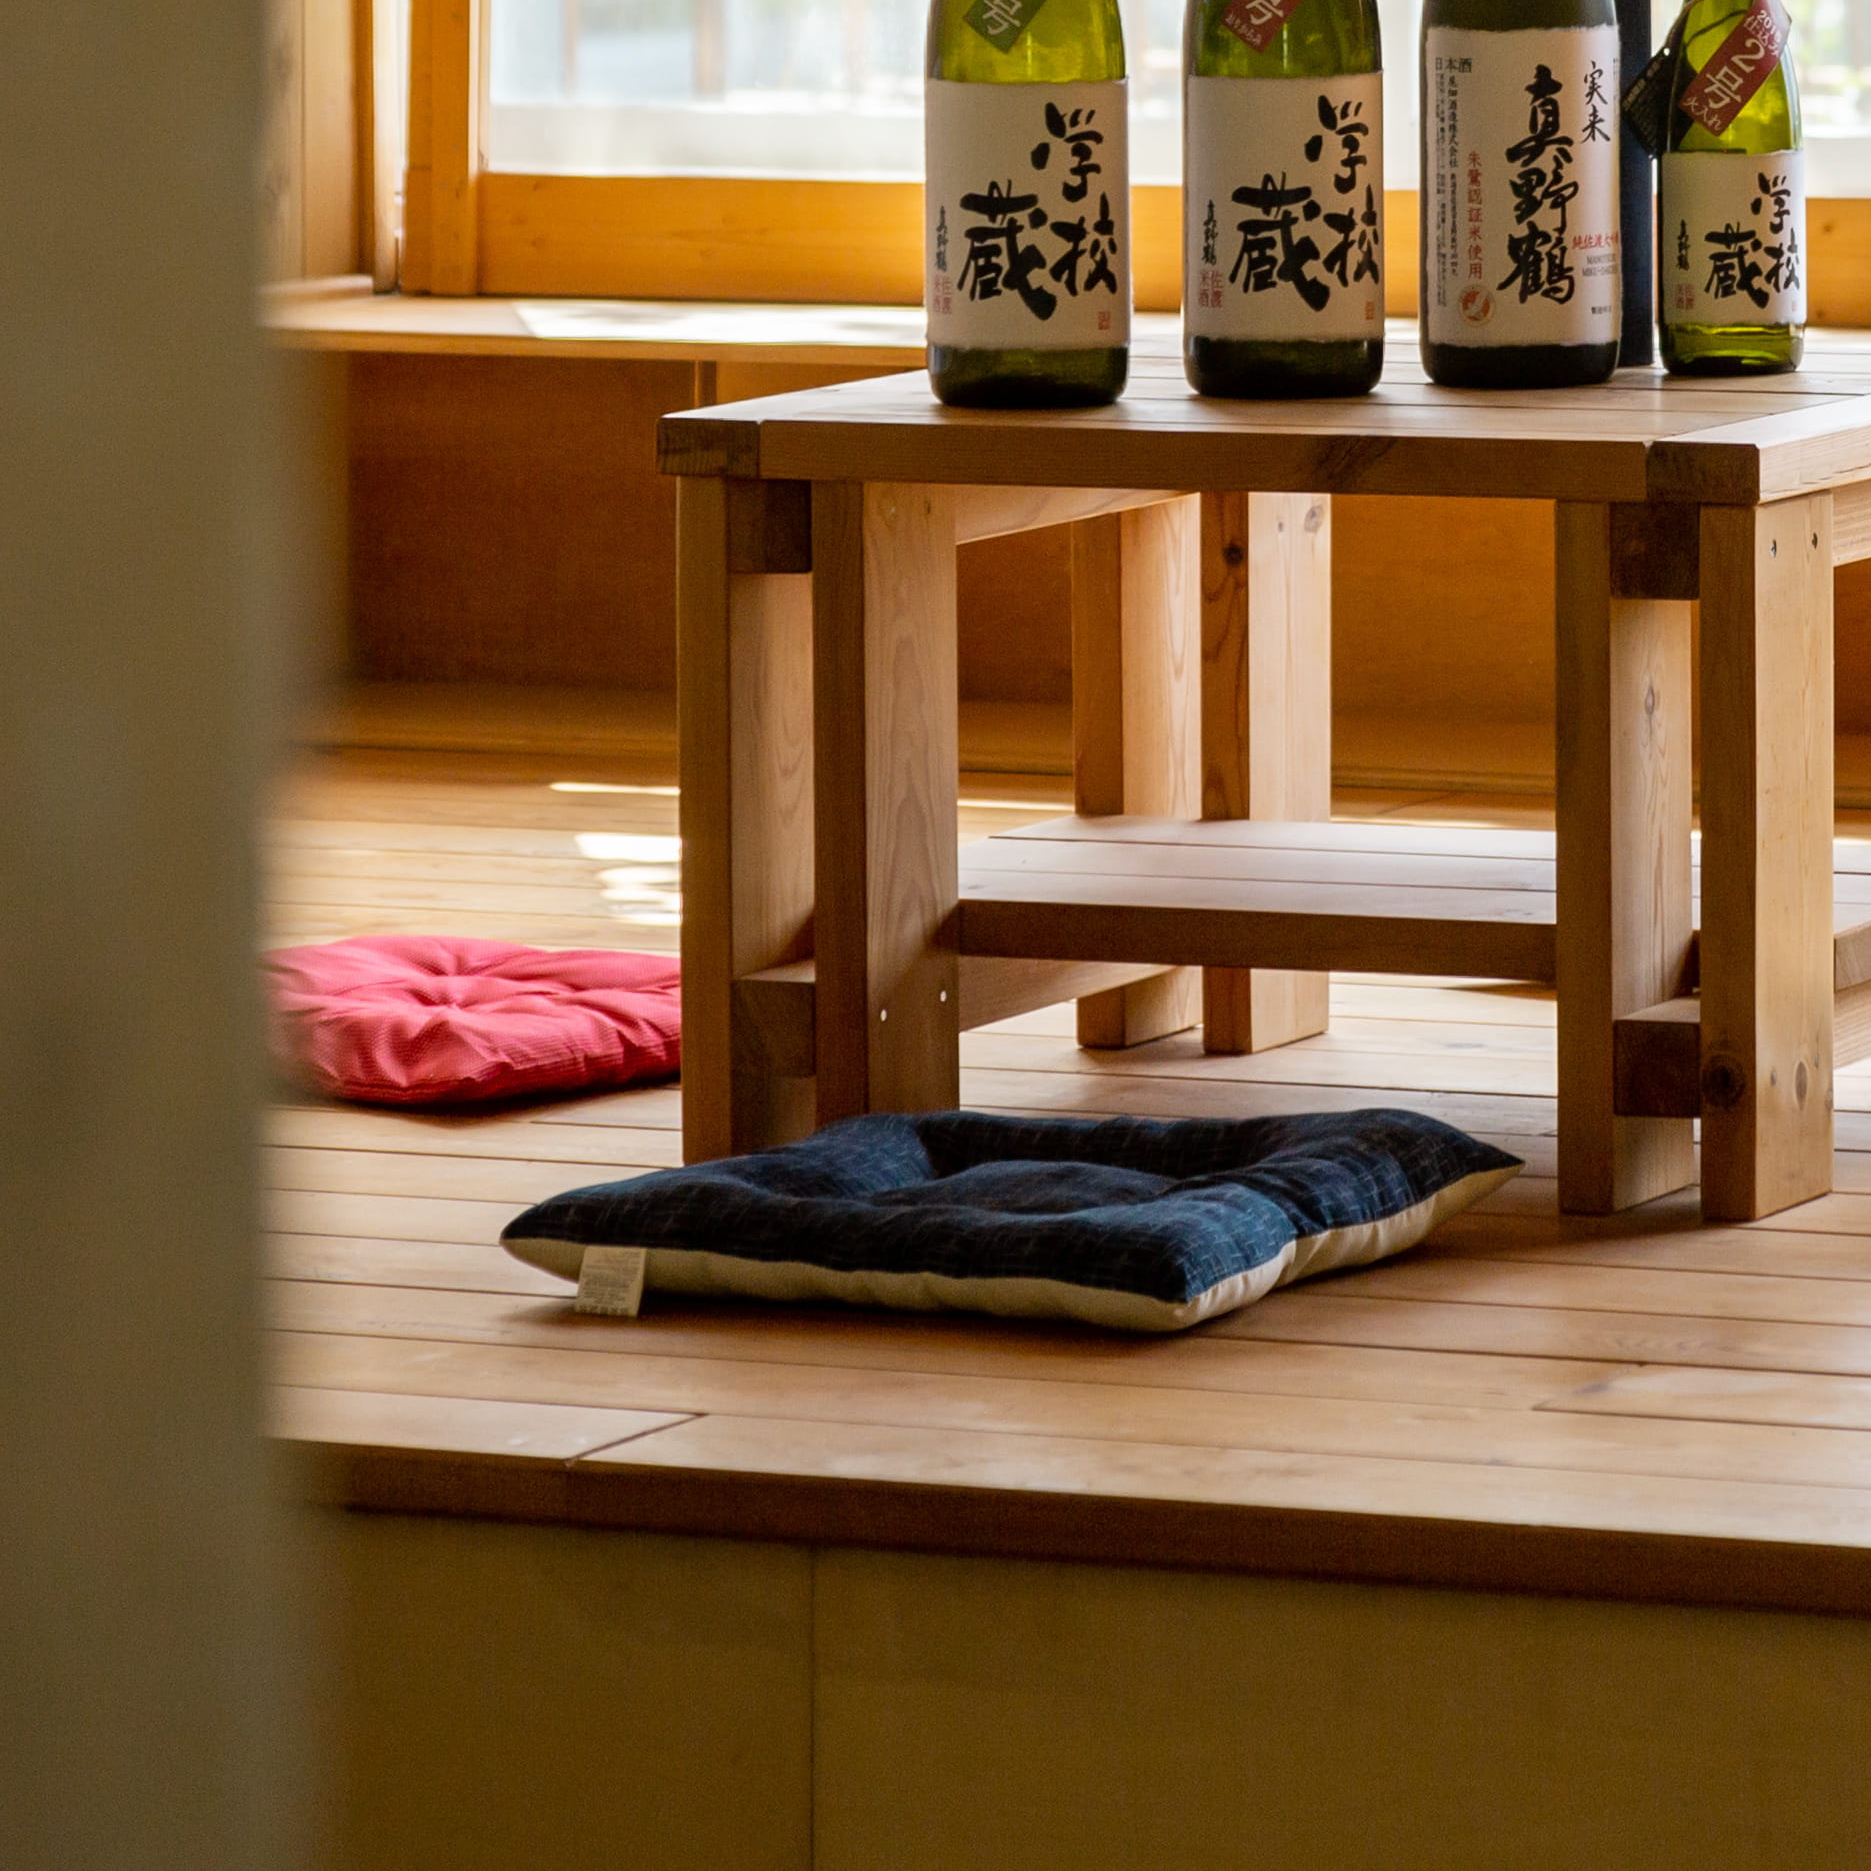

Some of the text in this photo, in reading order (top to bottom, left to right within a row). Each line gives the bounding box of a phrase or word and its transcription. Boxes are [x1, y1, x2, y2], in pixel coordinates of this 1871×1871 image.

[1743, 15, 1781, 58] 仕込み
[1435, 56, 1473, 74] 日本酒
[1703, 37, 1766, 110] 2号
[1682, 96, 1724, 131] 火入れ
[1495, 63, 1580, 305] 真野鶴
